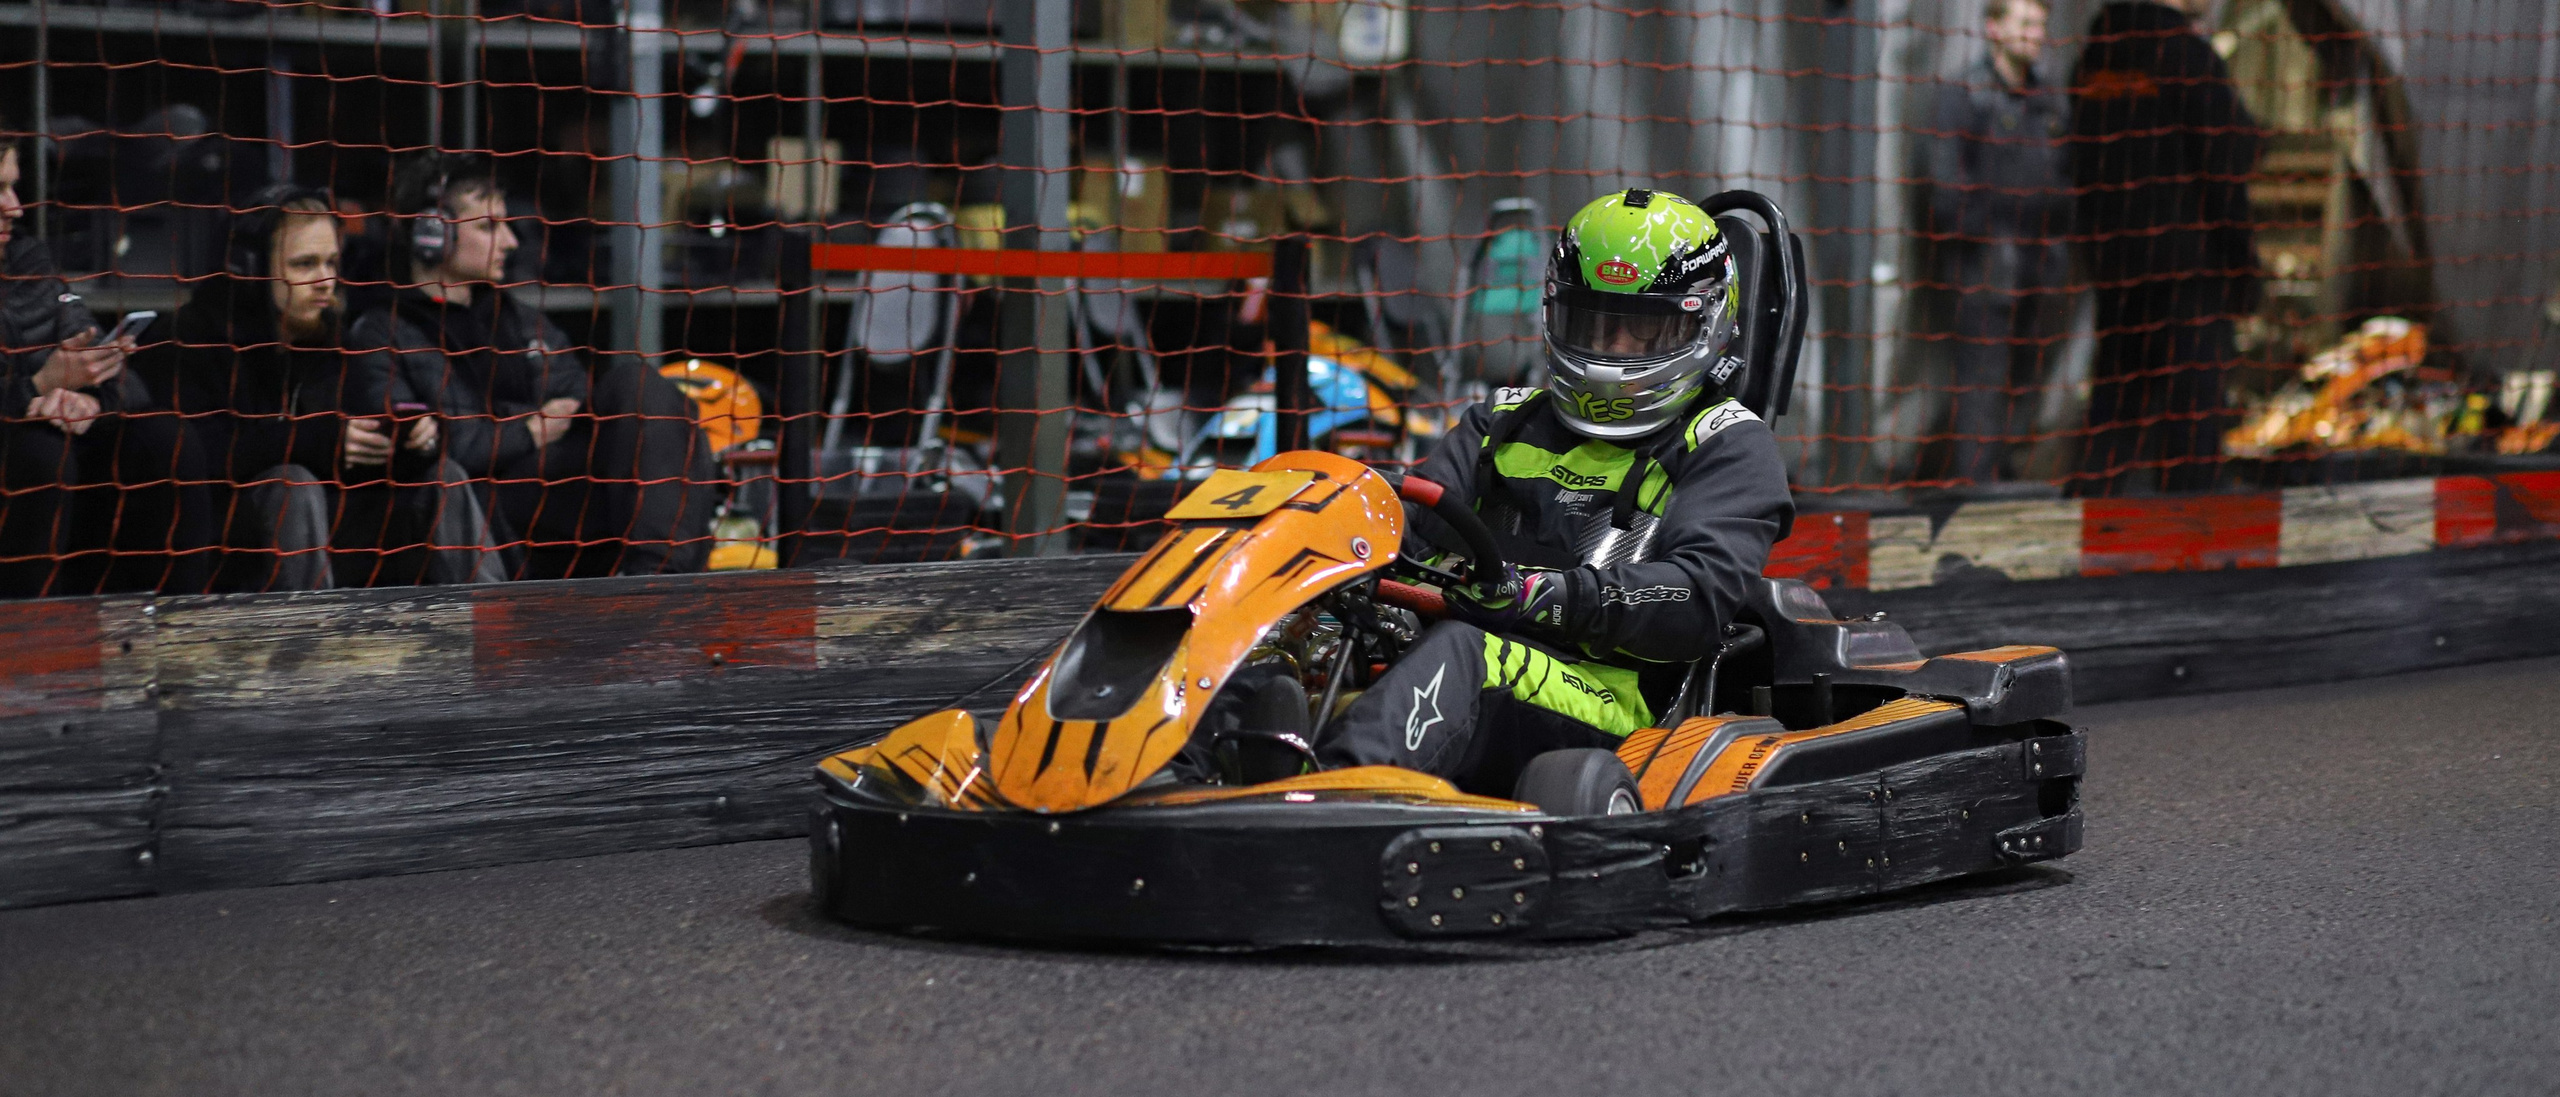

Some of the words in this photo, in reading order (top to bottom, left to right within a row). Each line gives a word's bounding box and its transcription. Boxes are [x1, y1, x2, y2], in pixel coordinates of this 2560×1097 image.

[1602, 265, 1634, 278] BELL
[1681, 243, 1727, 275] FORWARD
[1570, 389, 1635, 423] YES
[1210, 485, 1267, 510] 4
